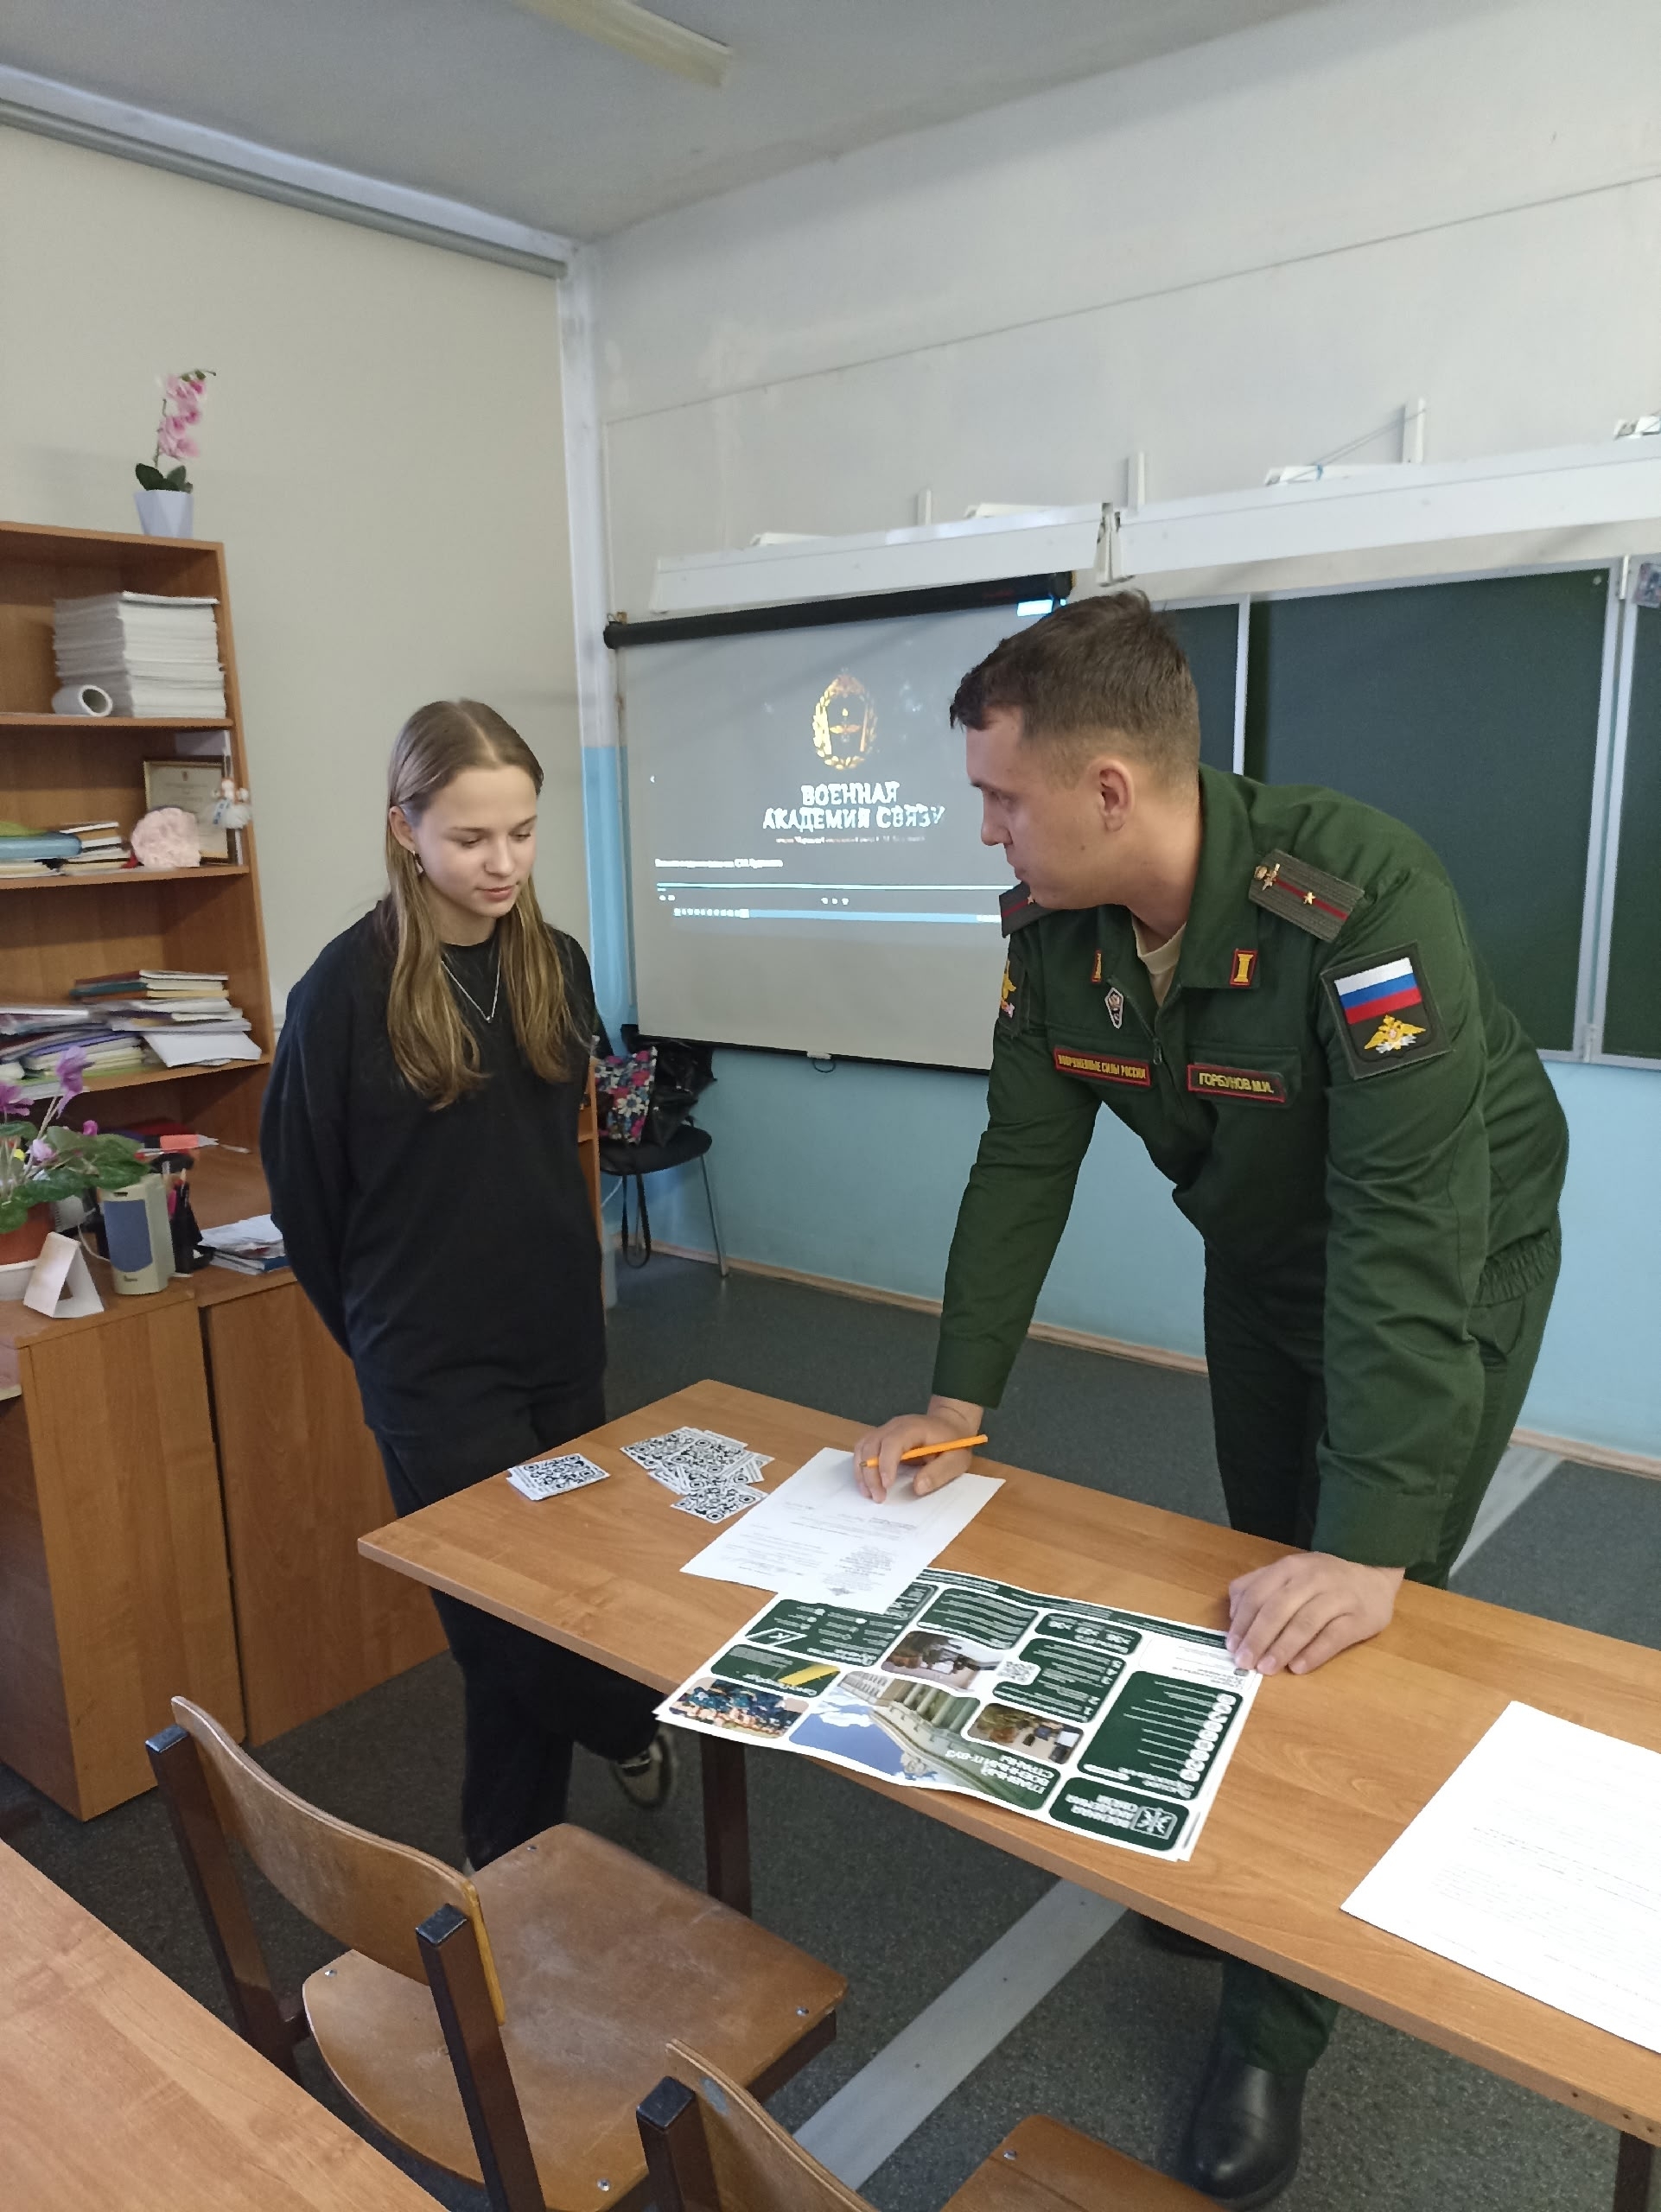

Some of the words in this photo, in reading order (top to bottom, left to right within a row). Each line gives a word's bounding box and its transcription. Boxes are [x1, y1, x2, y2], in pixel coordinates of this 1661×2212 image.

[801, 781, 900, 805] ВОЕННАЯ
[762, 806, 870, 832] АКАДЕМИЯ
[1102, 1062, 1120, 1075] СИЛЫ
[1121, 1065, 1146, 1078] РОССИИ
[1199, 1072, 1251, 1090] ГОРБУНОВ
